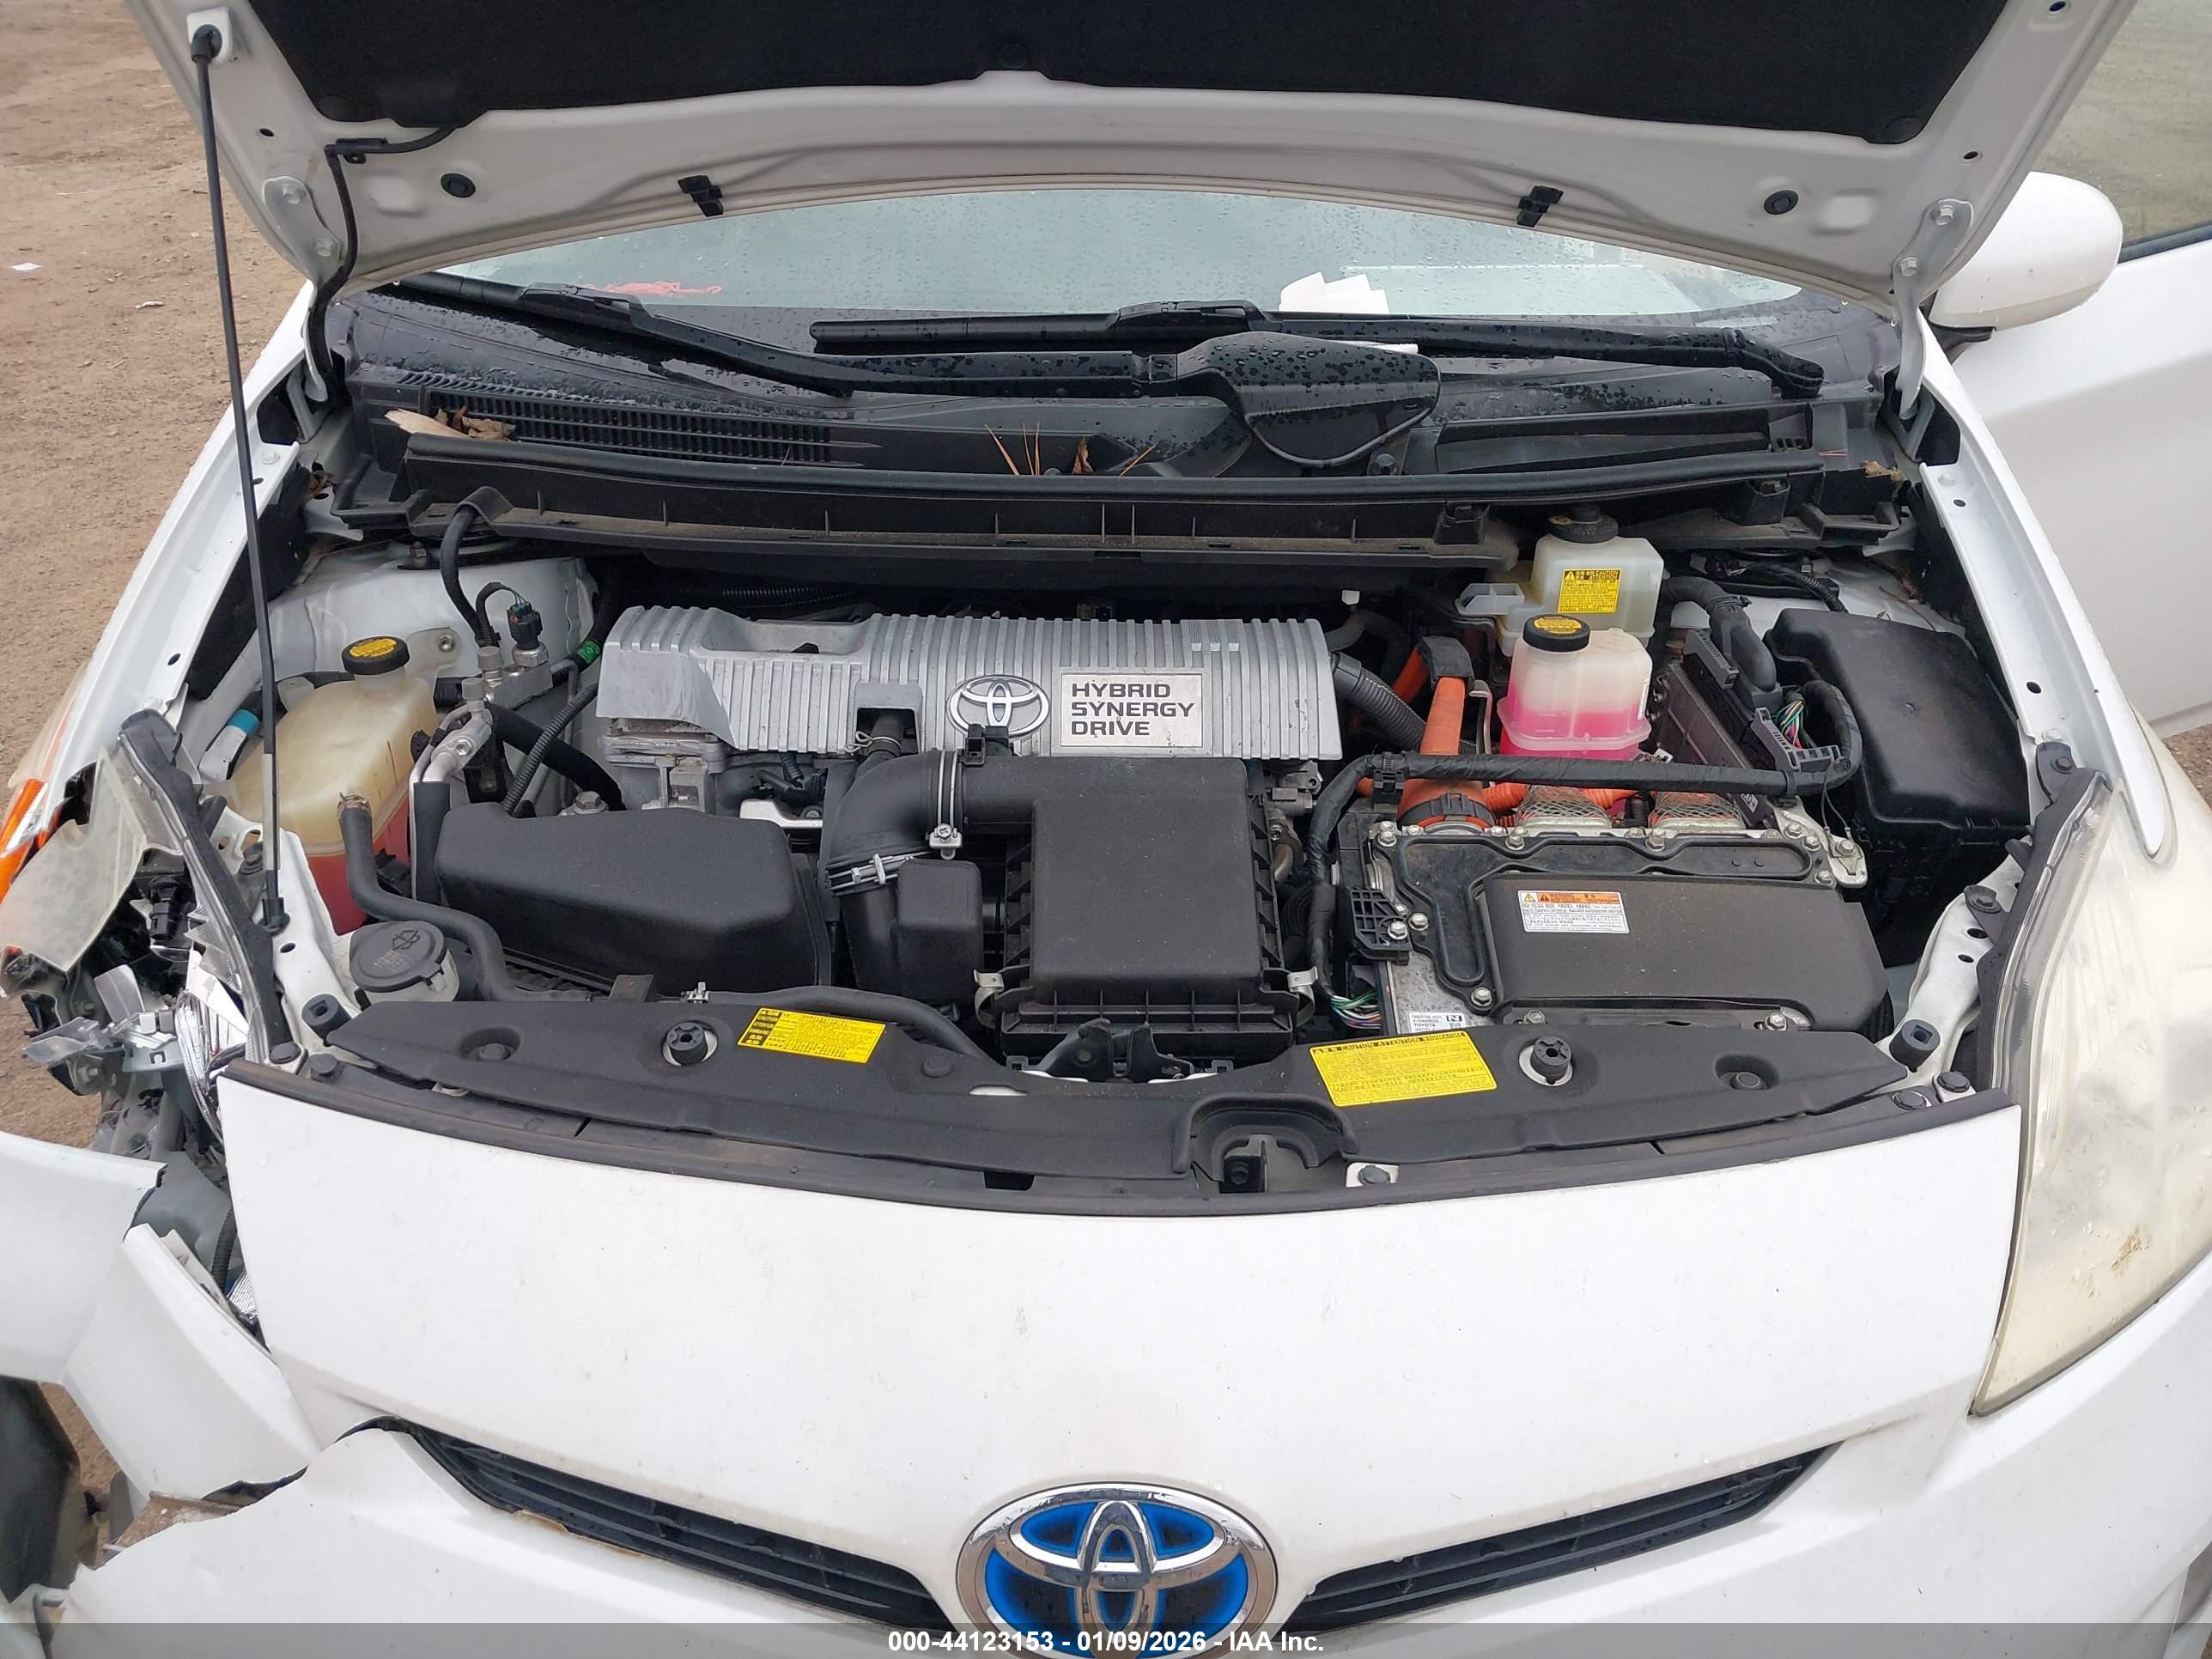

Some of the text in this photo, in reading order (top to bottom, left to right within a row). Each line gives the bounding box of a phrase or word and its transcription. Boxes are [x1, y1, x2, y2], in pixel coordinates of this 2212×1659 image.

[1072, 683, 1170, 698] HYBRID
[1071, 702, 1195, 717] SYNERGY
[1071, 720, 1151, 736] DRIVE
[1378, 1036, 1419, 1046] ATTENTION
